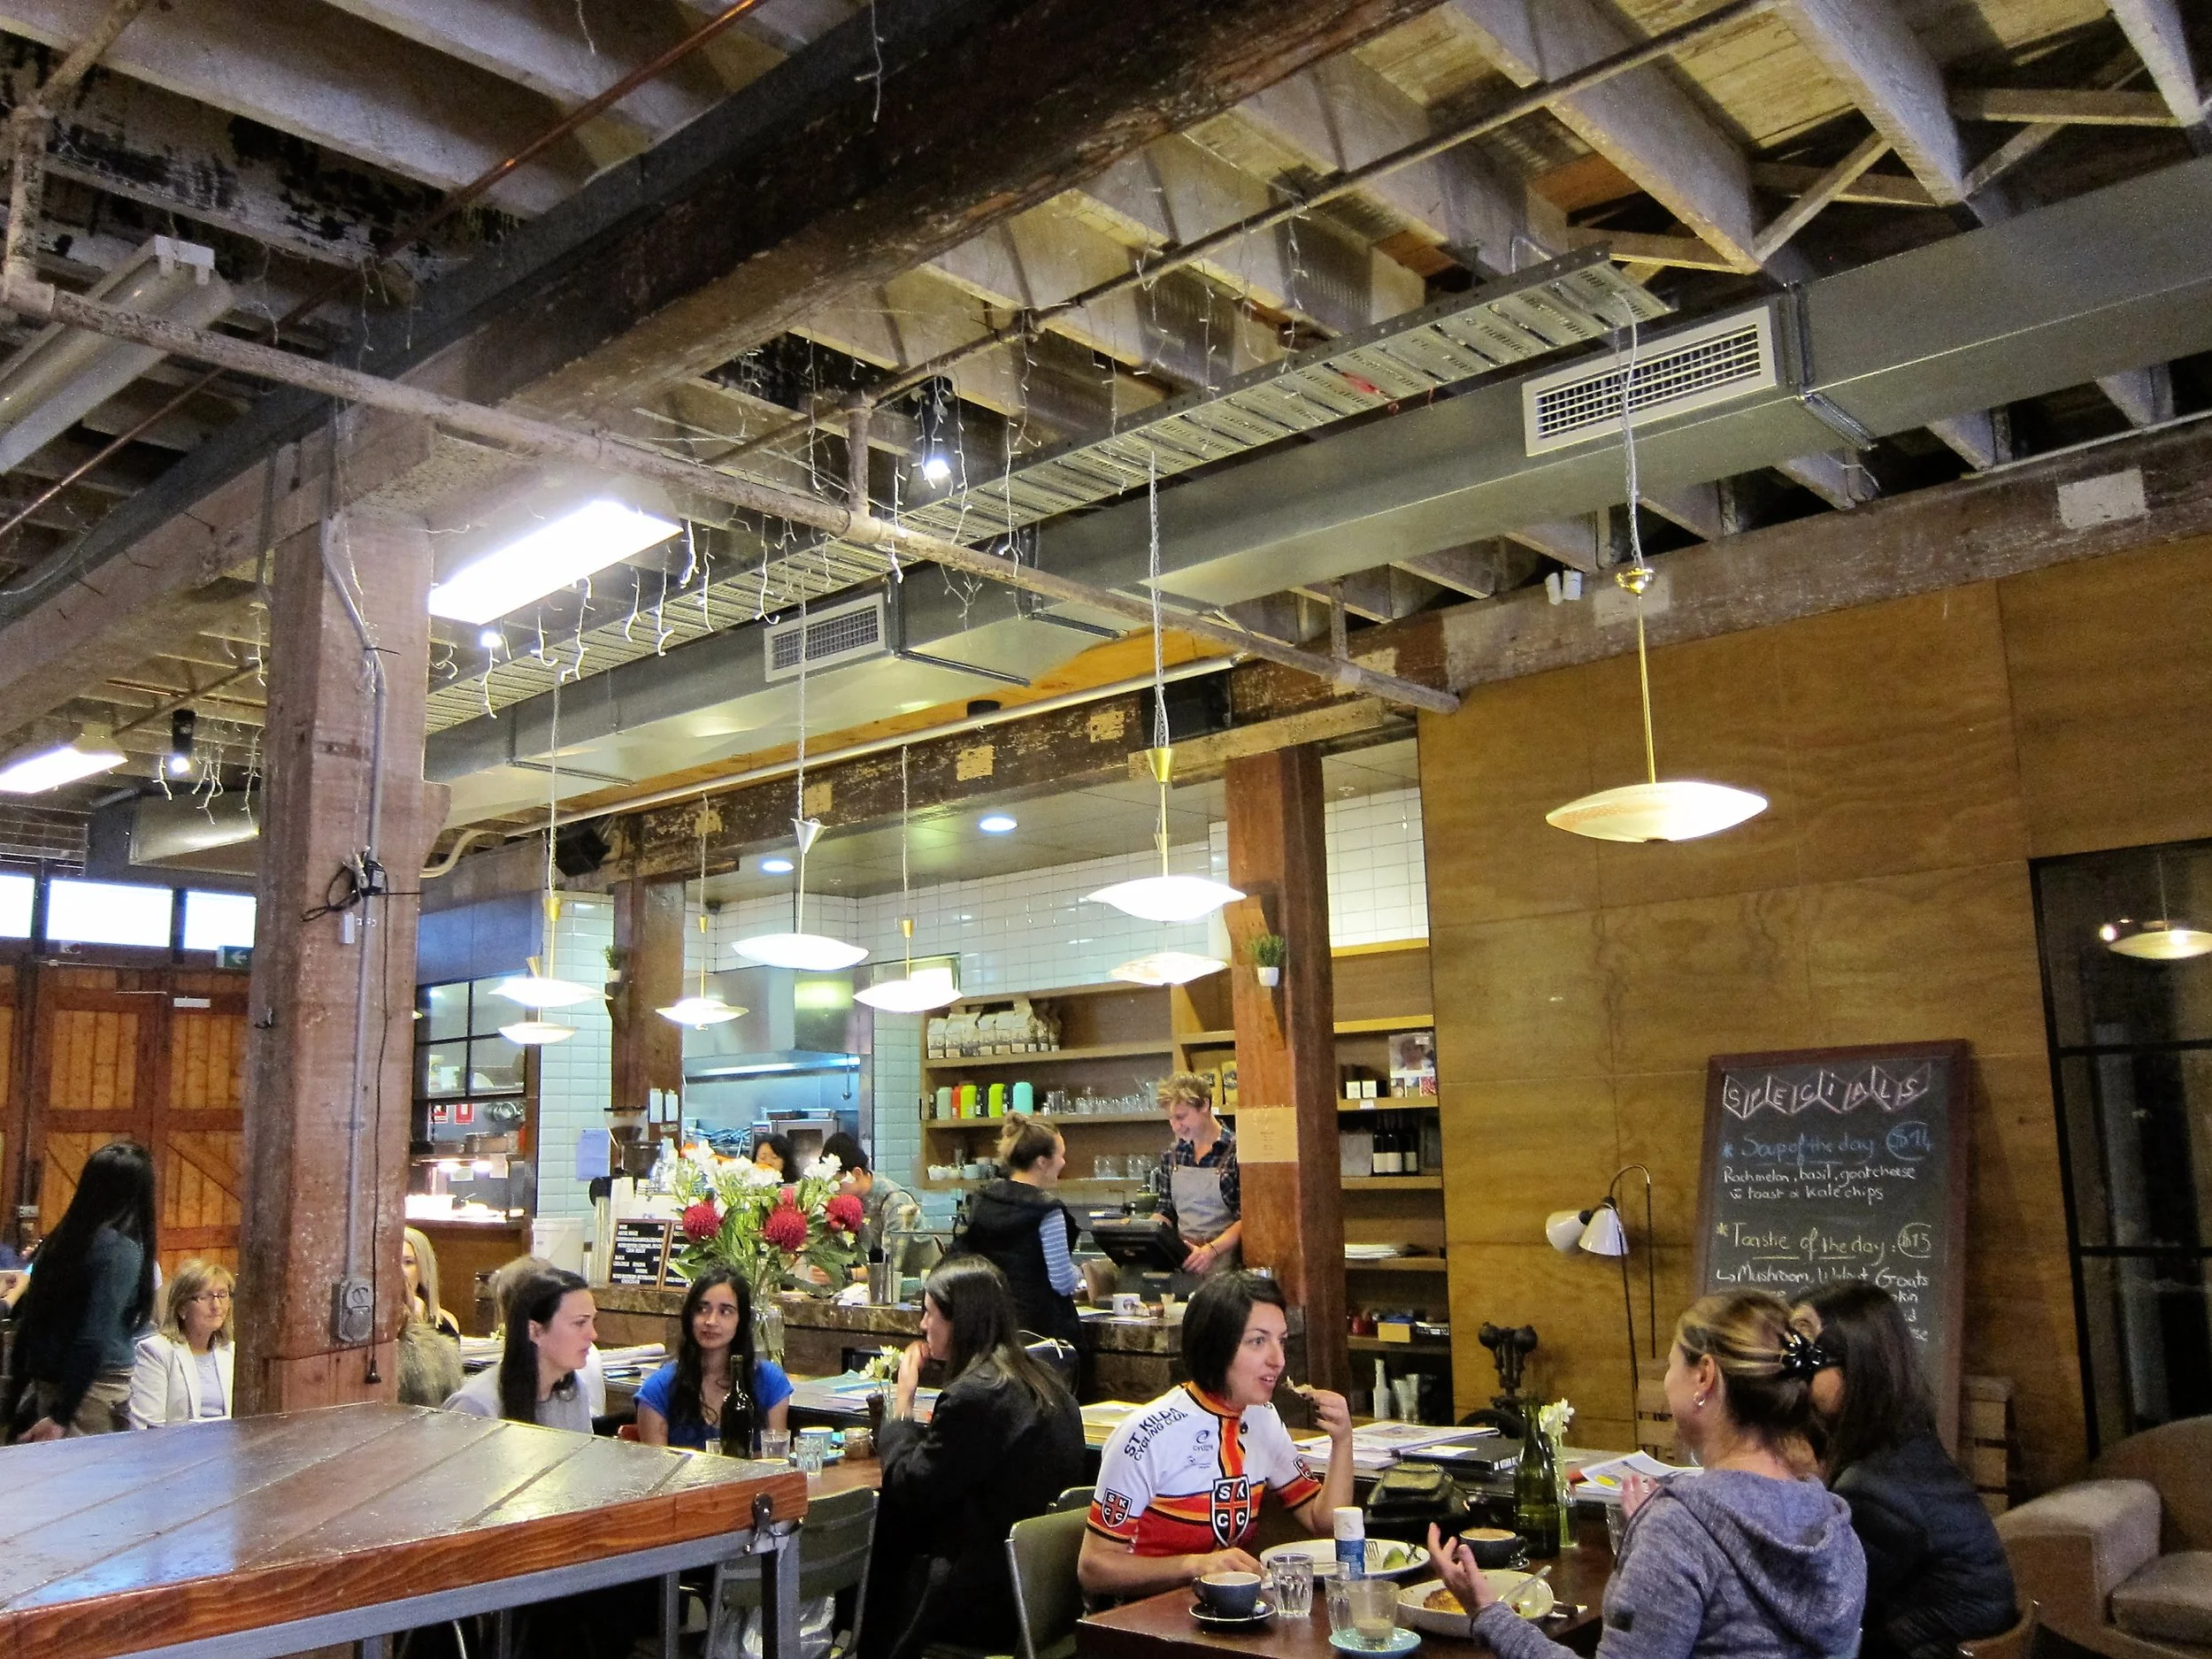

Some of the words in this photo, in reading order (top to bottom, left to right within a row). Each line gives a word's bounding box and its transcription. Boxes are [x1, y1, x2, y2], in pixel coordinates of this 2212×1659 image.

[1747, 1186, 1785, 1200] toast
[1800, 1226, 1818, 1262] of
[1822, 1236, 1847, 1254] the
[1124, 1432, 1141, 1457] ST
[1139, 1408, 1181, 1432] KILDA
[1133, 1423, 1164, 1462] CYCLING
